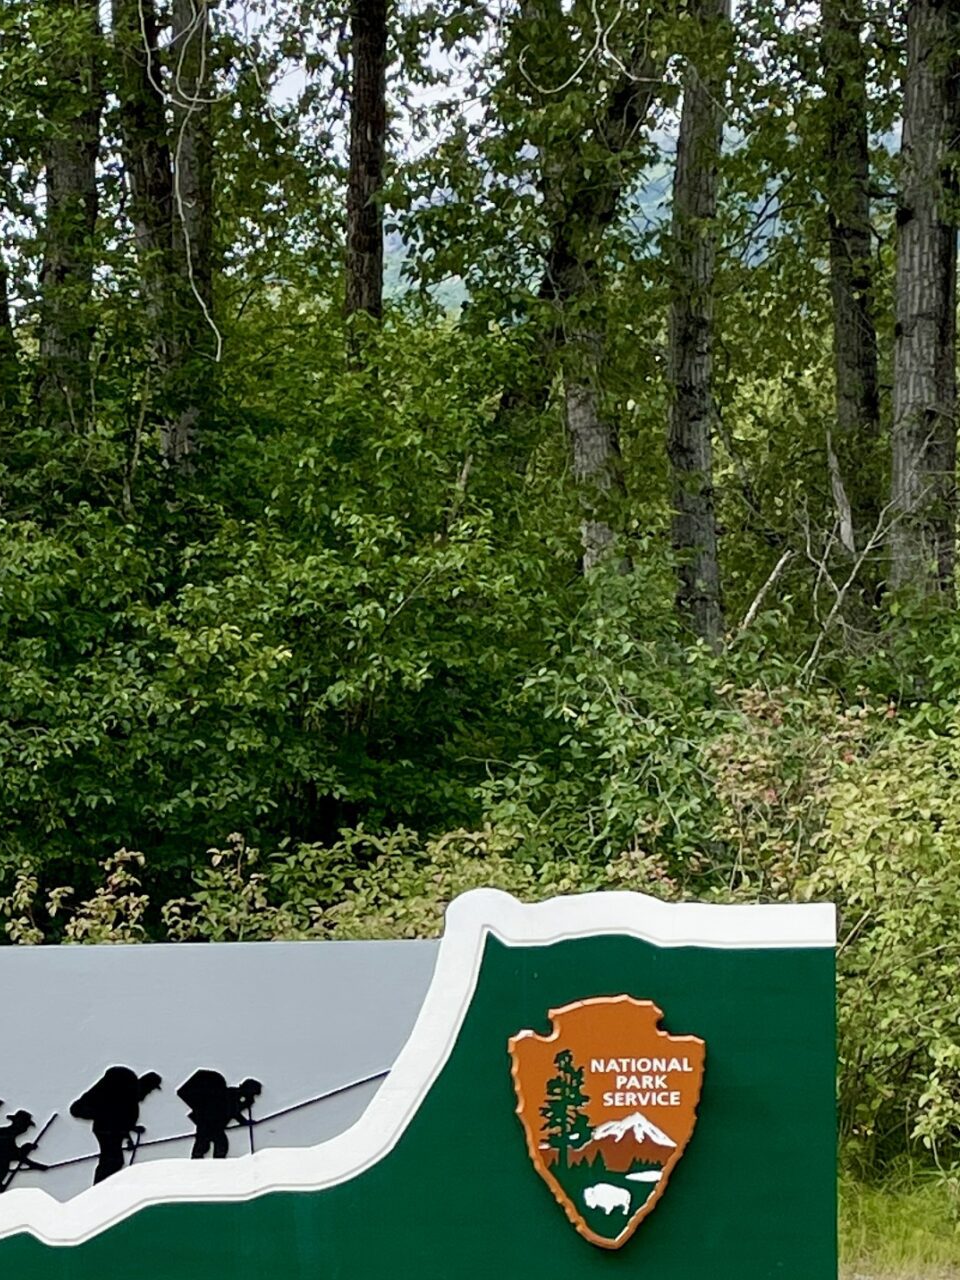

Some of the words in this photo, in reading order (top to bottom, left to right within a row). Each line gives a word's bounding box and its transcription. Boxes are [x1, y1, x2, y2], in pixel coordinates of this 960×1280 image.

[590, 1057, 693, 1073] NATIONAL
[615, 1075, 668, 1089] PARK
[602, 1091, 681, 1107] SERVICE
